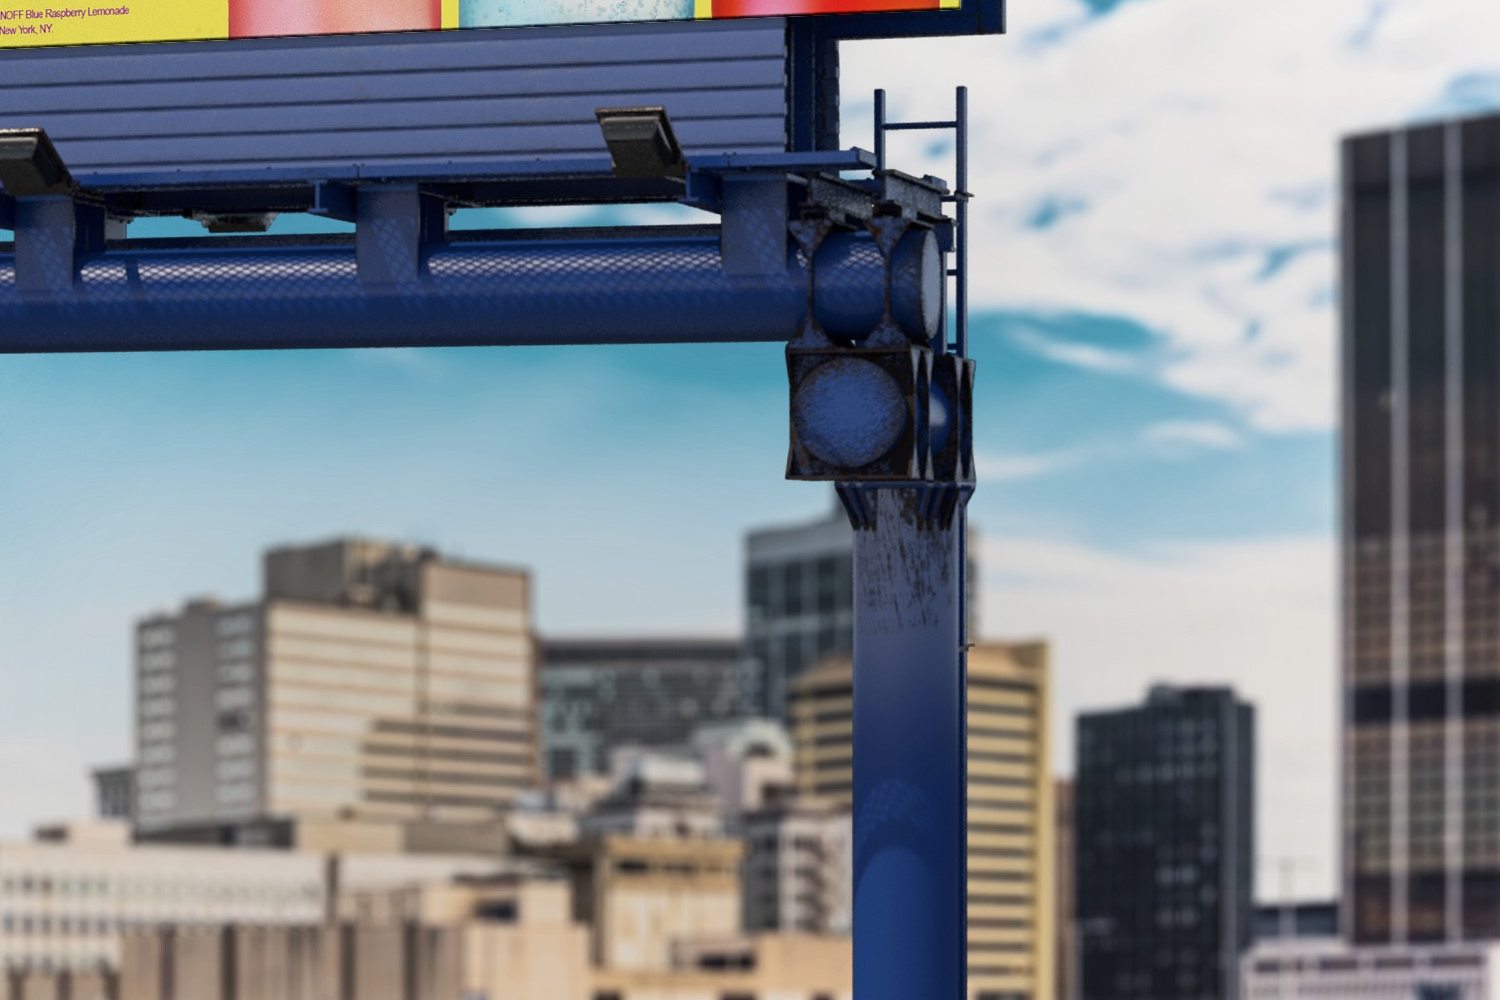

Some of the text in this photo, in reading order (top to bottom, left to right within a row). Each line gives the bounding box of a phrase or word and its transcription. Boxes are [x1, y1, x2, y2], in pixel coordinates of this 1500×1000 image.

[25, 9, 43, 19] Blue
[45, 8, 86, 20] Raspberry
[88, 5, 130, 17] Lemonade
[18, 25, 38, 35] York,
[39, 23, 54, 34] NY.
